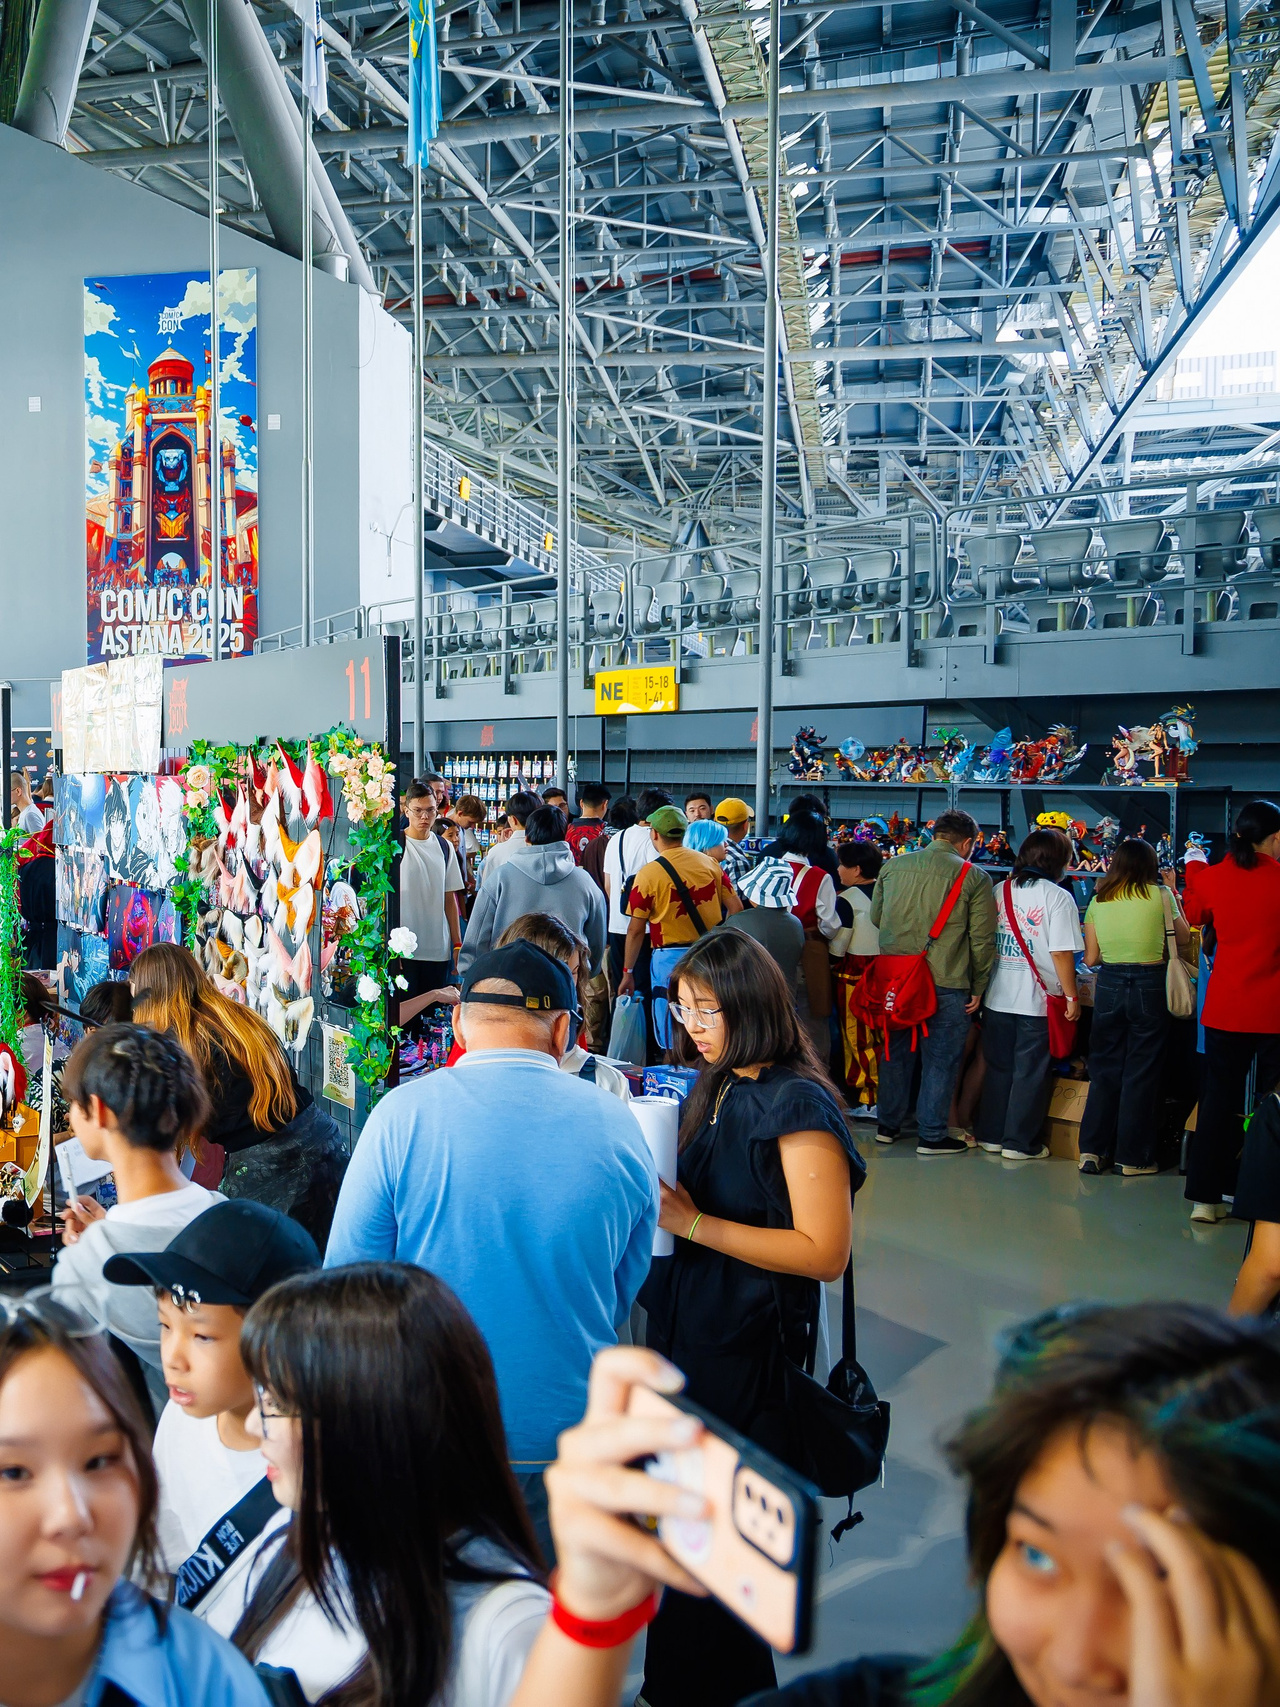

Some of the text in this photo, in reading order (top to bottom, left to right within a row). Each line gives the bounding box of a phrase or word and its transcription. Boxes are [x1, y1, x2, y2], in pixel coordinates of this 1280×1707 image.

[161, 319, 179, 331] CON
[190, 586, 244, 621] CON
[100, 623, 245, 655] ASTANA 2025
[345, 656, 371, 721] 11
[601, 682, 623, 701] NE
[644, 675, 669, 689] 15-18
[644, 692, 663, 705] 1-41
